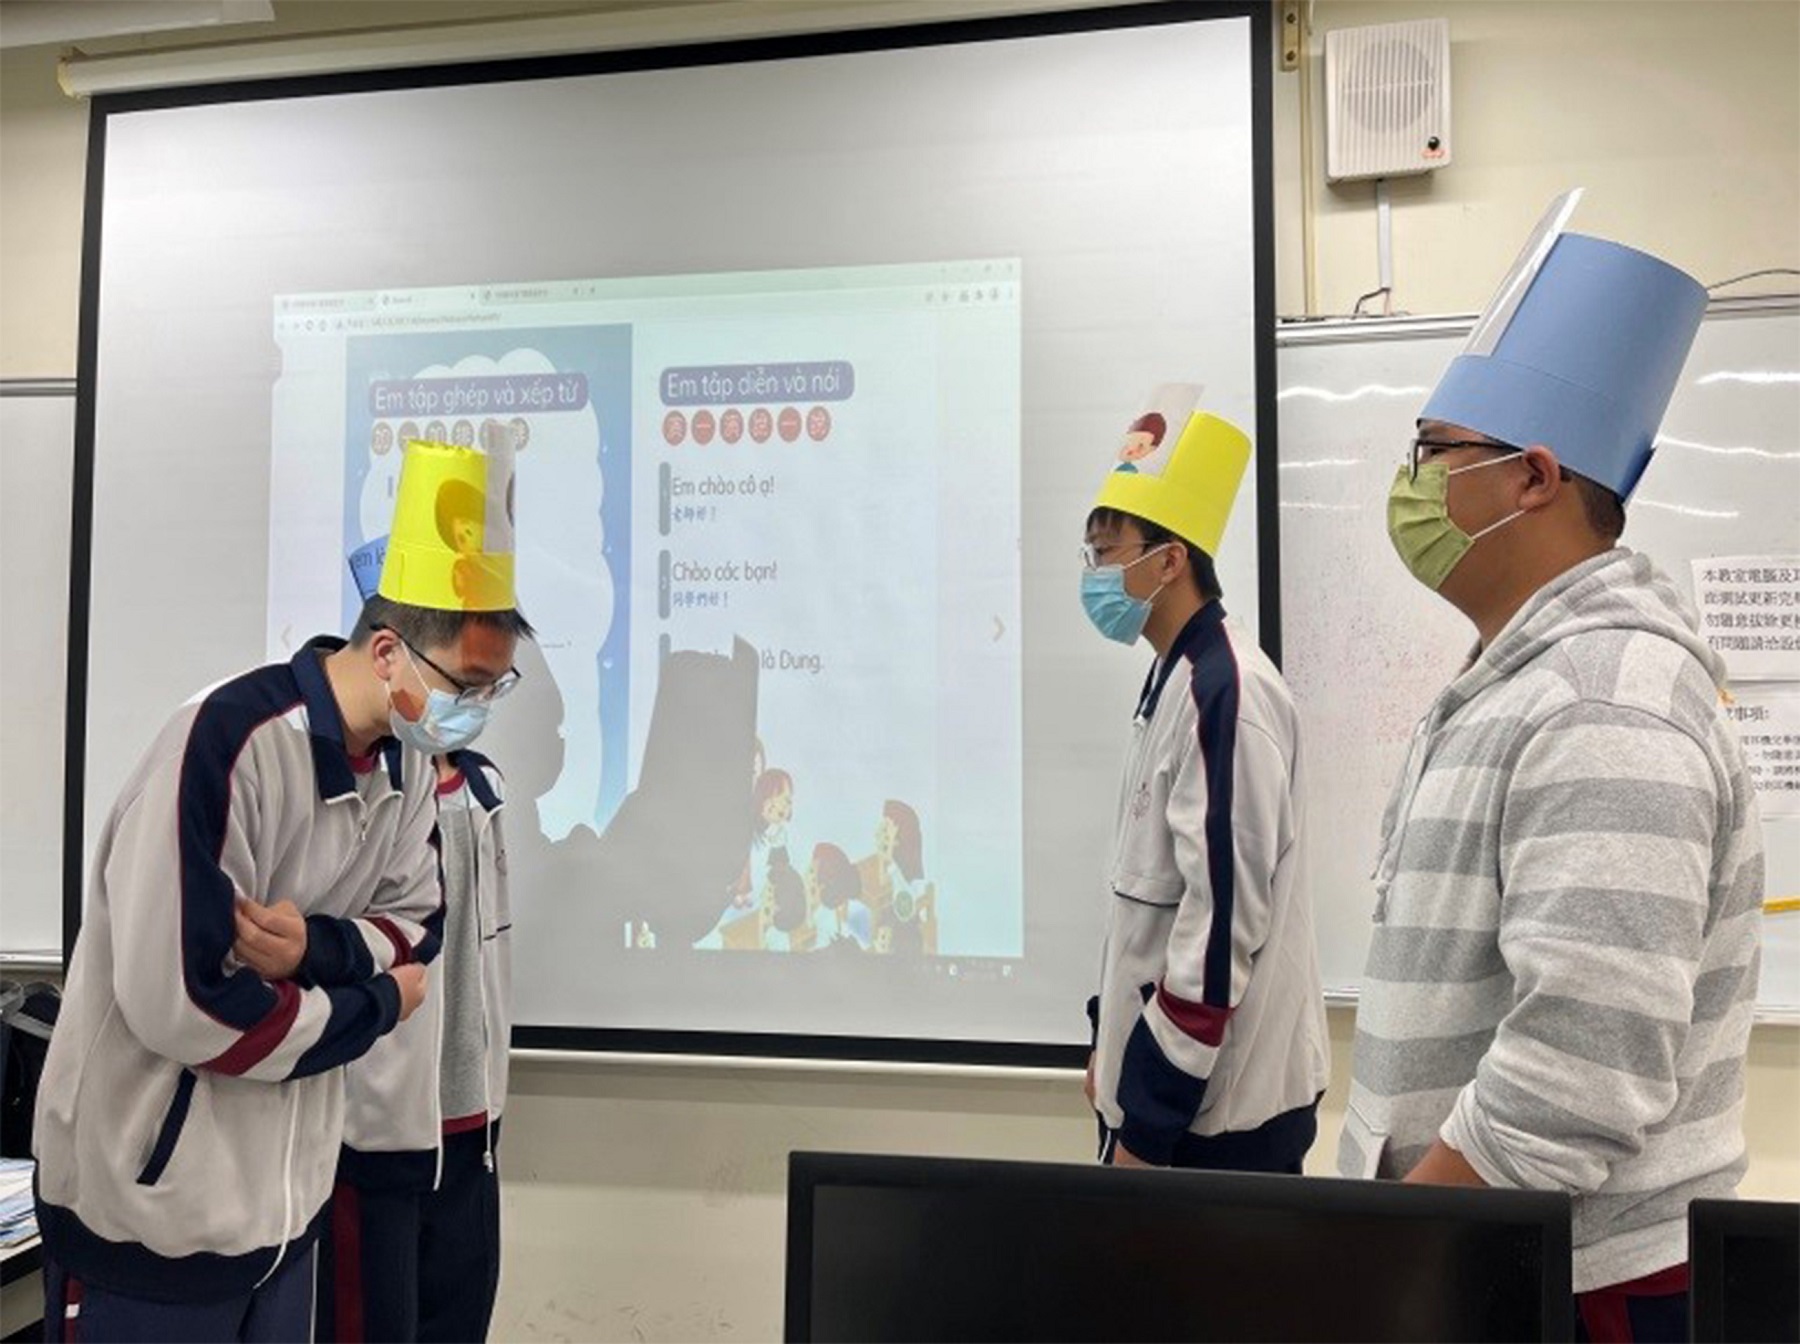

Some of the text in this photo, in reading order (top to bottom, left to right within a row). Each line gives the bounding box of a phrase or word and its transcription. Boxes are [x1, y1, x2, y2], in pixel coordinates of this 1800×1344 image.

[667, 373, 697, 397] Em
[812, 366, 840, 393] nói
[375, 386, 403, 410] Em
[672, 477, 695, 496] Em
[698, 475, 735, 495] chào
[739, 473, 756, 495] cô
[672, 560, 711, 581] Chào
[761, 649, 776, 669] là
